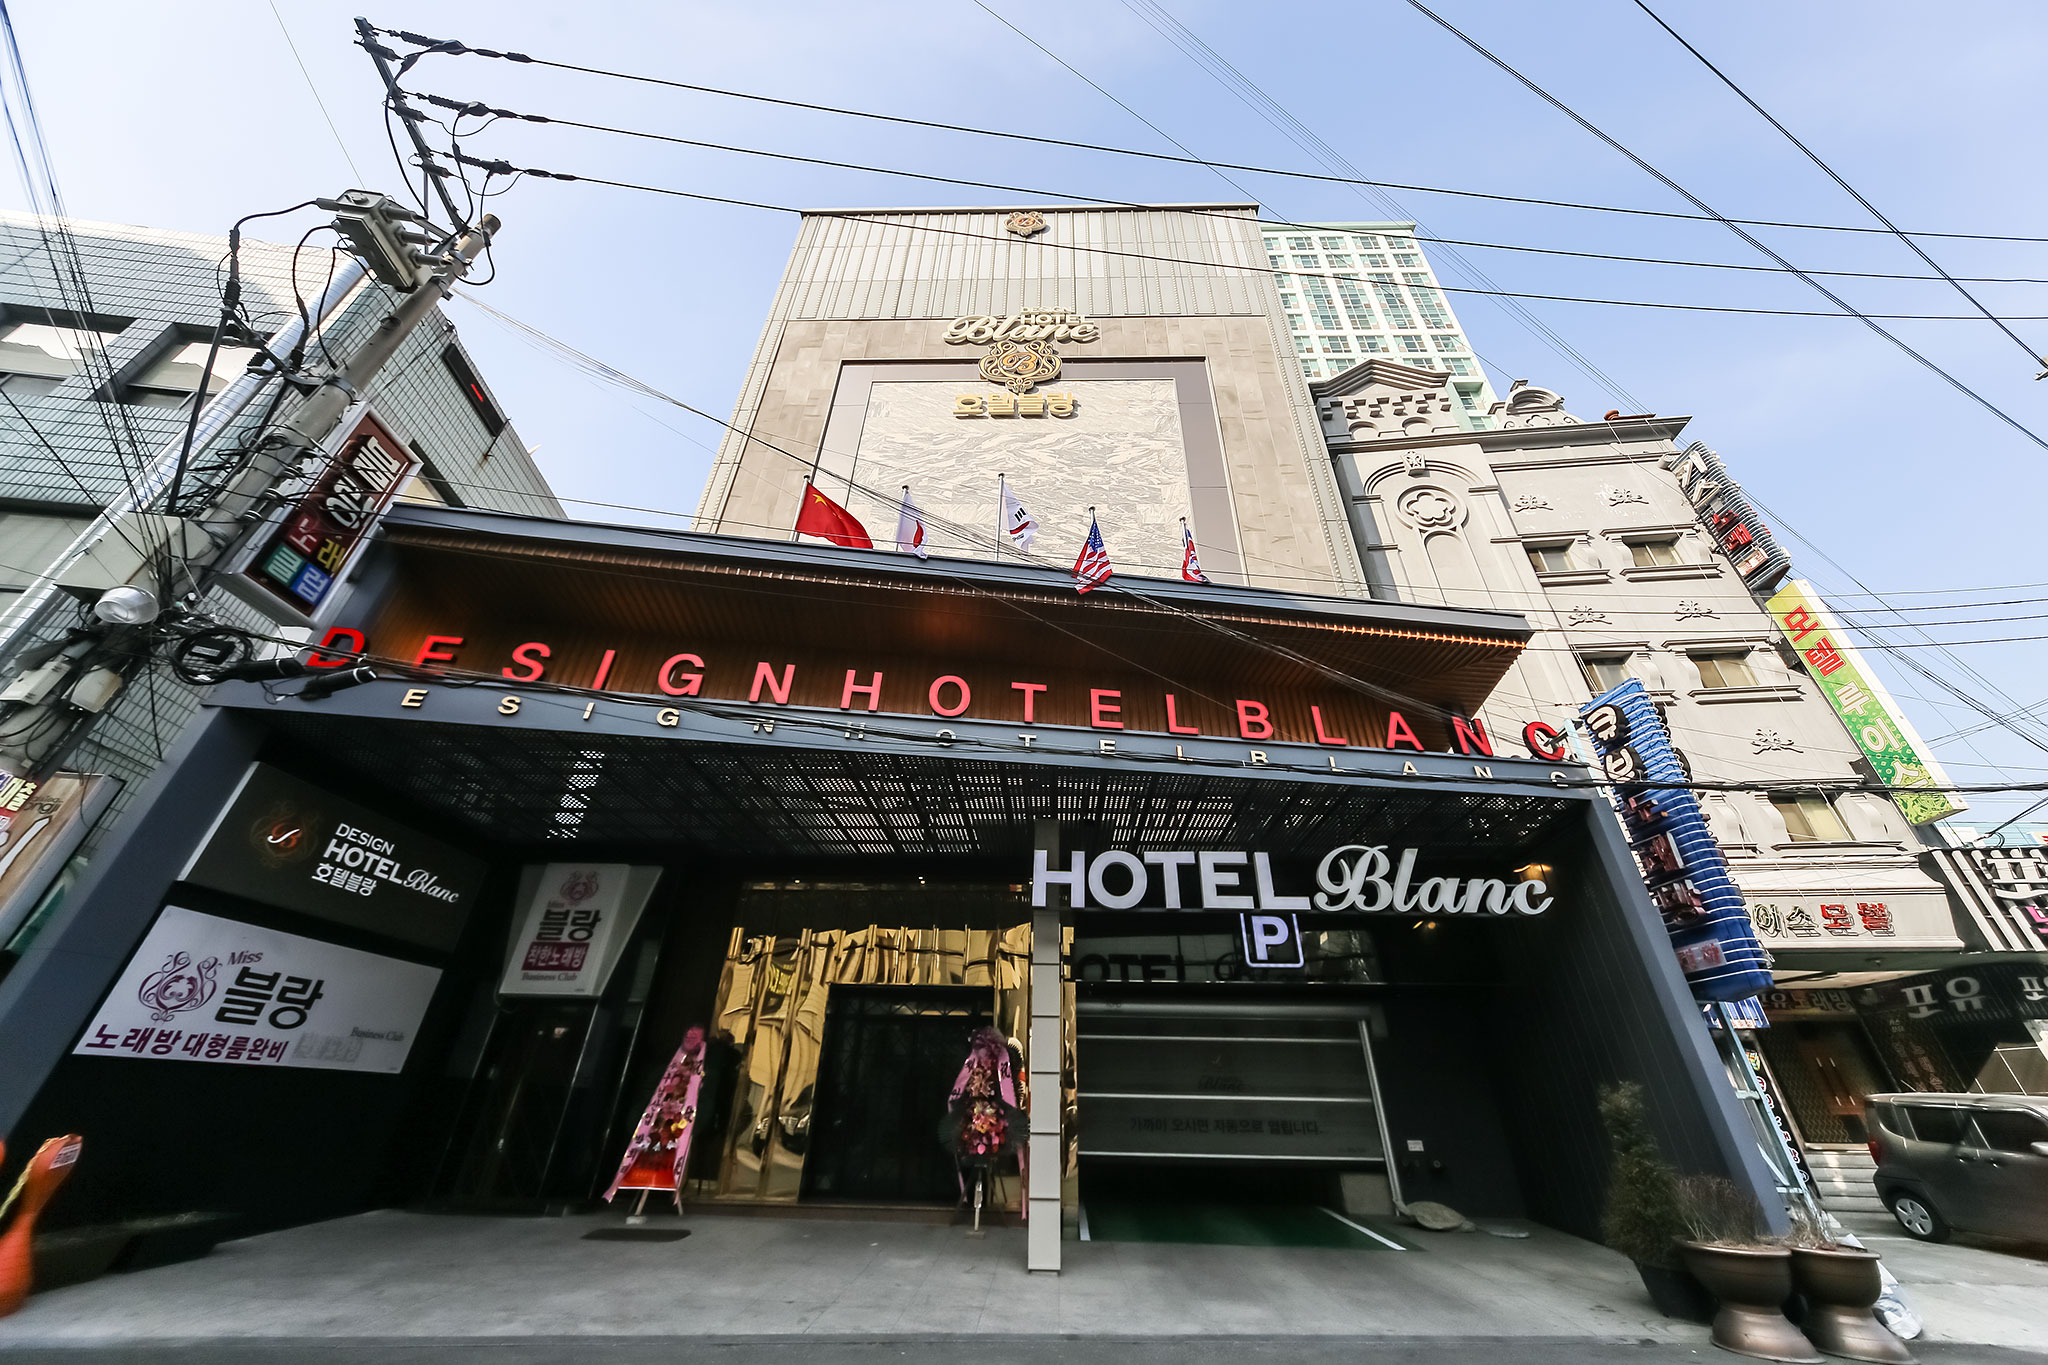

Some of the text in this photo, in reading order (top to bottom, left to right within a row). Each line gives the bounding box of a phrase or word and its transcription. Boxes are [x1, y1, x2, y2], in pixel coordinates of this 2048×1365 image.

[1021, 306, 1073, 315] DESIGN
[1021, 314, 1095, 326] HOTEL
[941, 315, 1101, 345] Blanc
[953, 391, 1077, 418] 호텔블랑
[335, 823, 395, 855] DESIGN
[311, 863, 378, 897] 호텔블랑
[323, 839, 460, 904] HOTEL Blanc
[1031, 844, 1555, 916] HOTEL Blanc
[536, 909, 602, 942] 블랑
[1253, 915, 1289, 961] P
[227, 951, 263, 967] Miss
[521, 973, 577, 982] Business Club
[214, 966, 324, 1029] 블랑
[1901, 976, 1986, 1018] 포유
[86, 1023, 182, 1054] 노래방
[181, 1031, 290, 1063] 대형룸완비
[350, 1026, 384, 1040] Business
